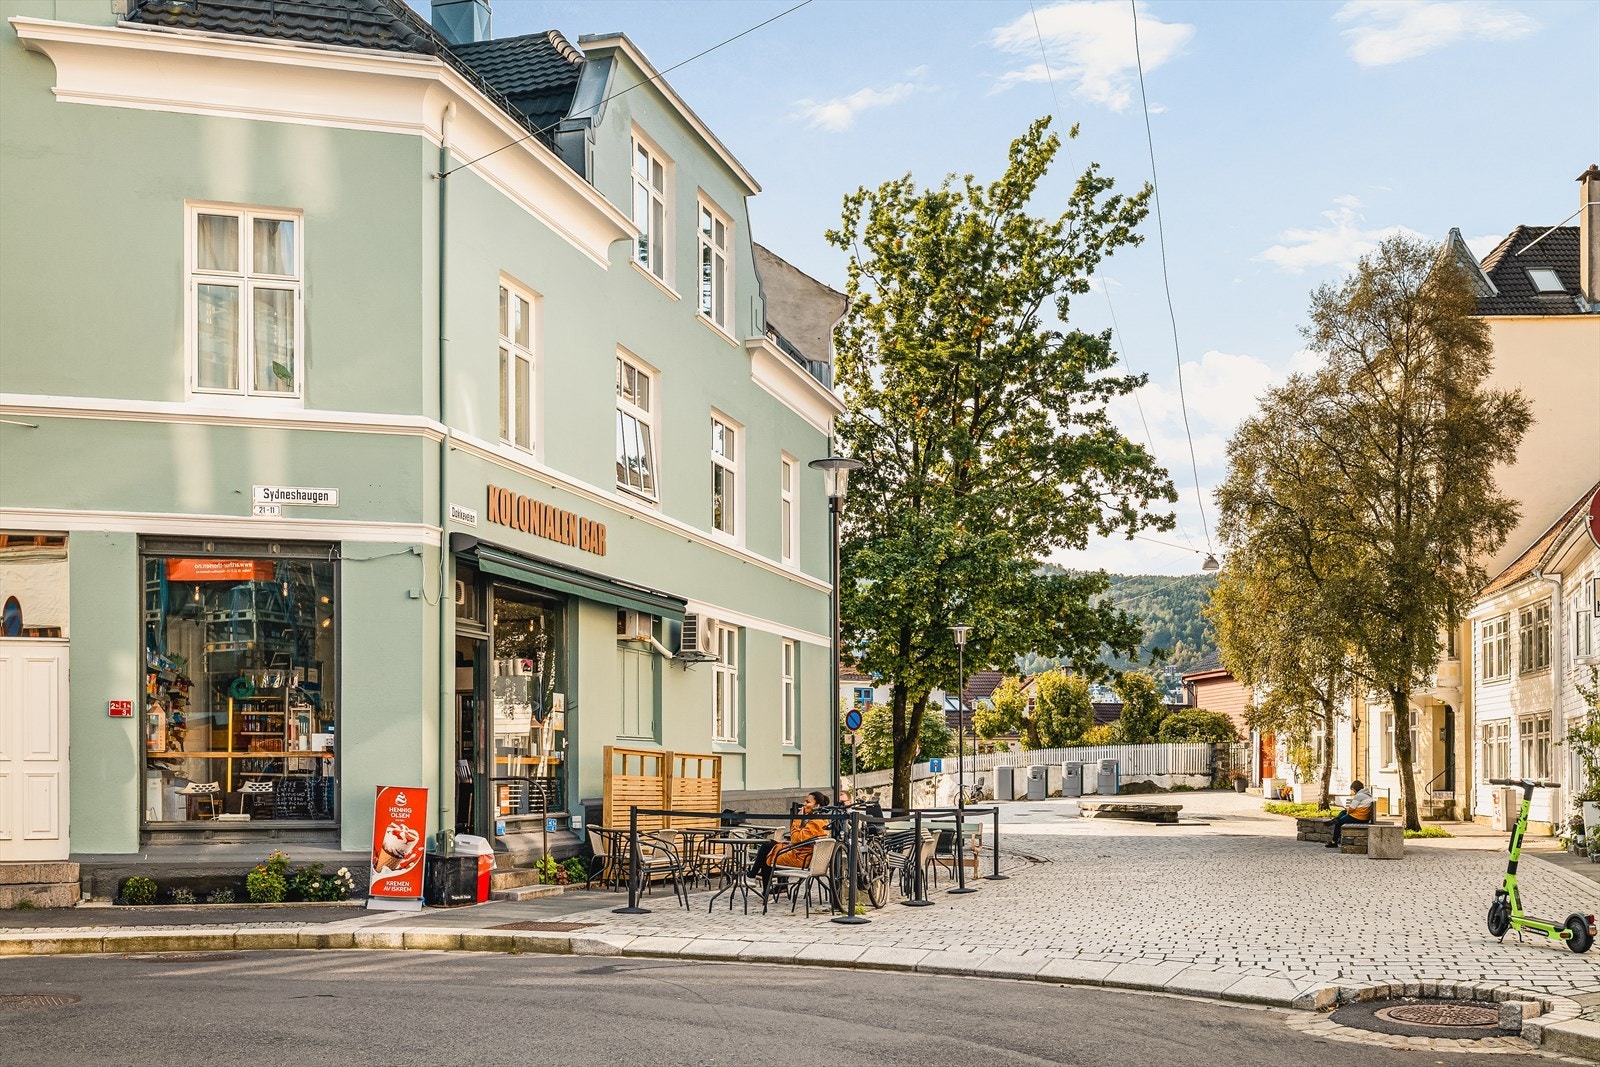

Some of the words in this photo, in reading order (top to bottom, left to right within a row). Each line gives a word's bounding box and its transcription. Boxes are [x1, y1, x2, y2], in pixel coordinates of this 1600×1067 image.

[263, 488, 329, 503] Sydneshaugen
[487, 484, 577, 547] KOLONIALEN
[580, 516, 606, 556] BAR
